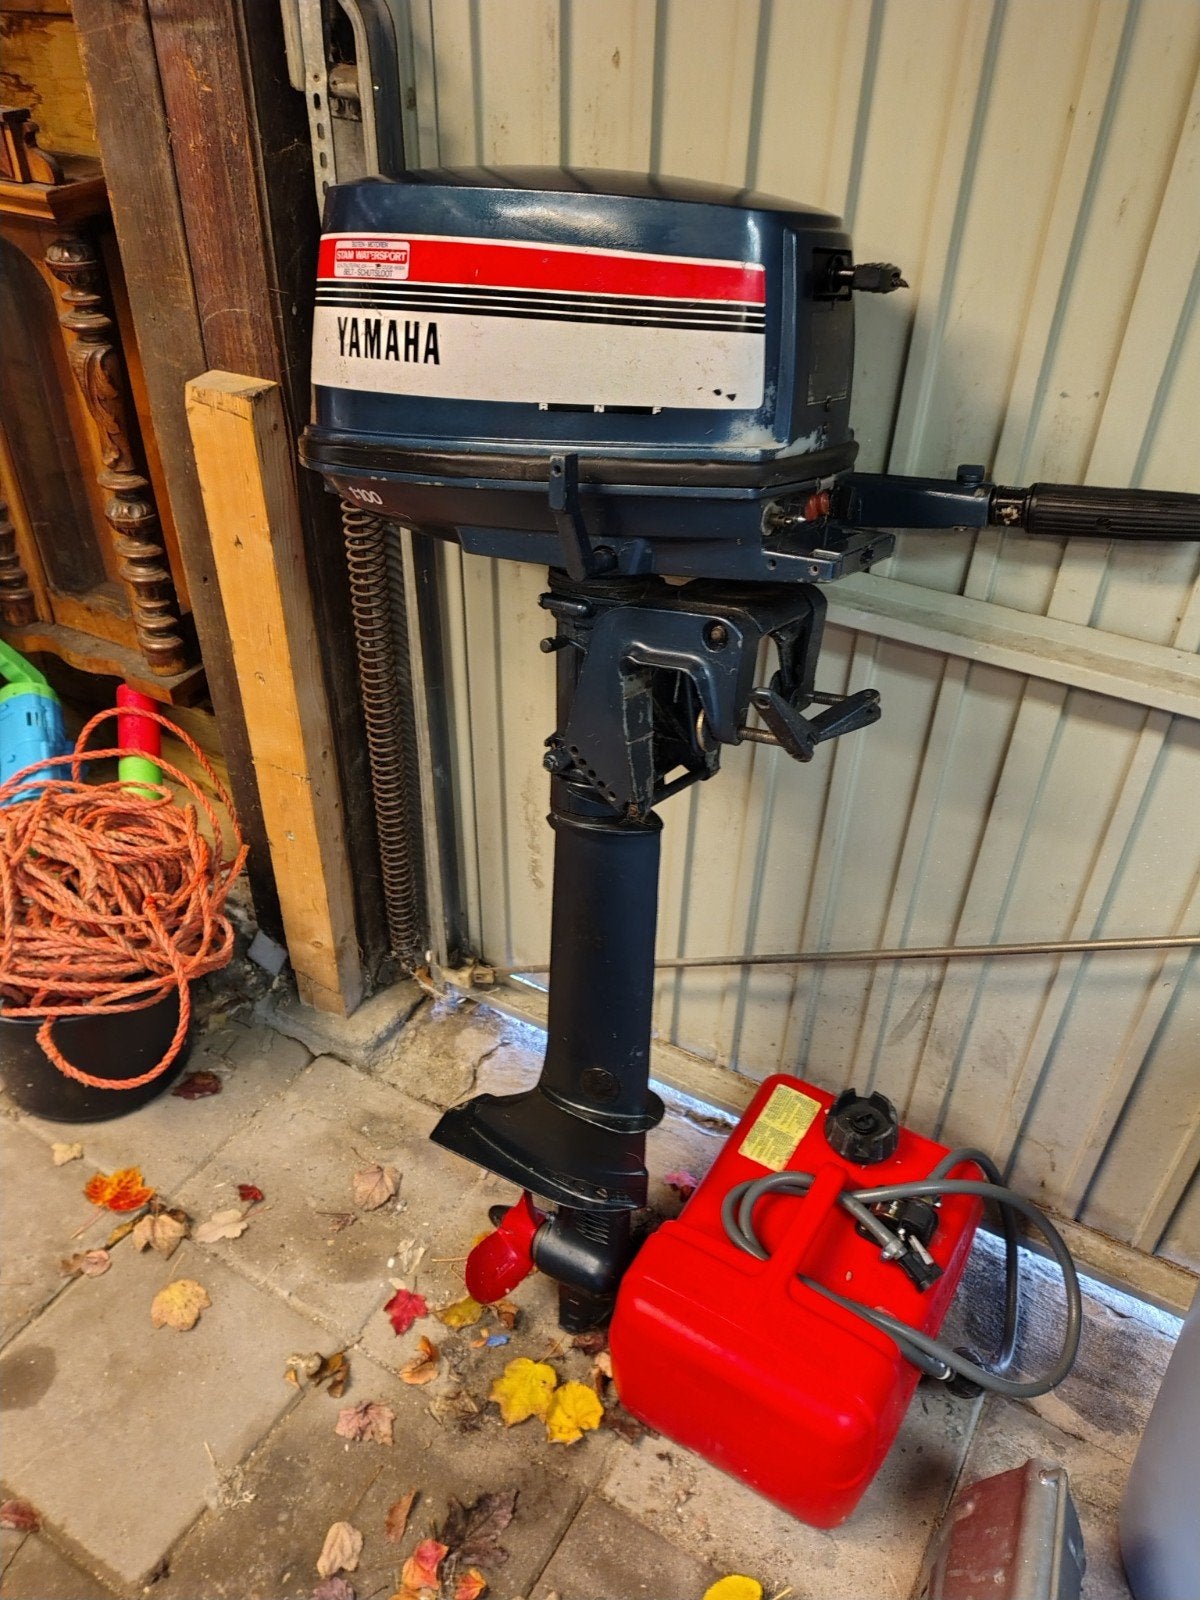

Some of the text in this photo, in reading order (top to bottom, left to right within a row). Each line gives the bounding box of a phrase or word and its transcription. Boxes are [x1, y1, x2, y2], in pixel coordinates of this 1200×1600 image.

[336, 250, 407, 262] STAM WATERSPORT
[337, 316, 440, 365] YAMAHA
